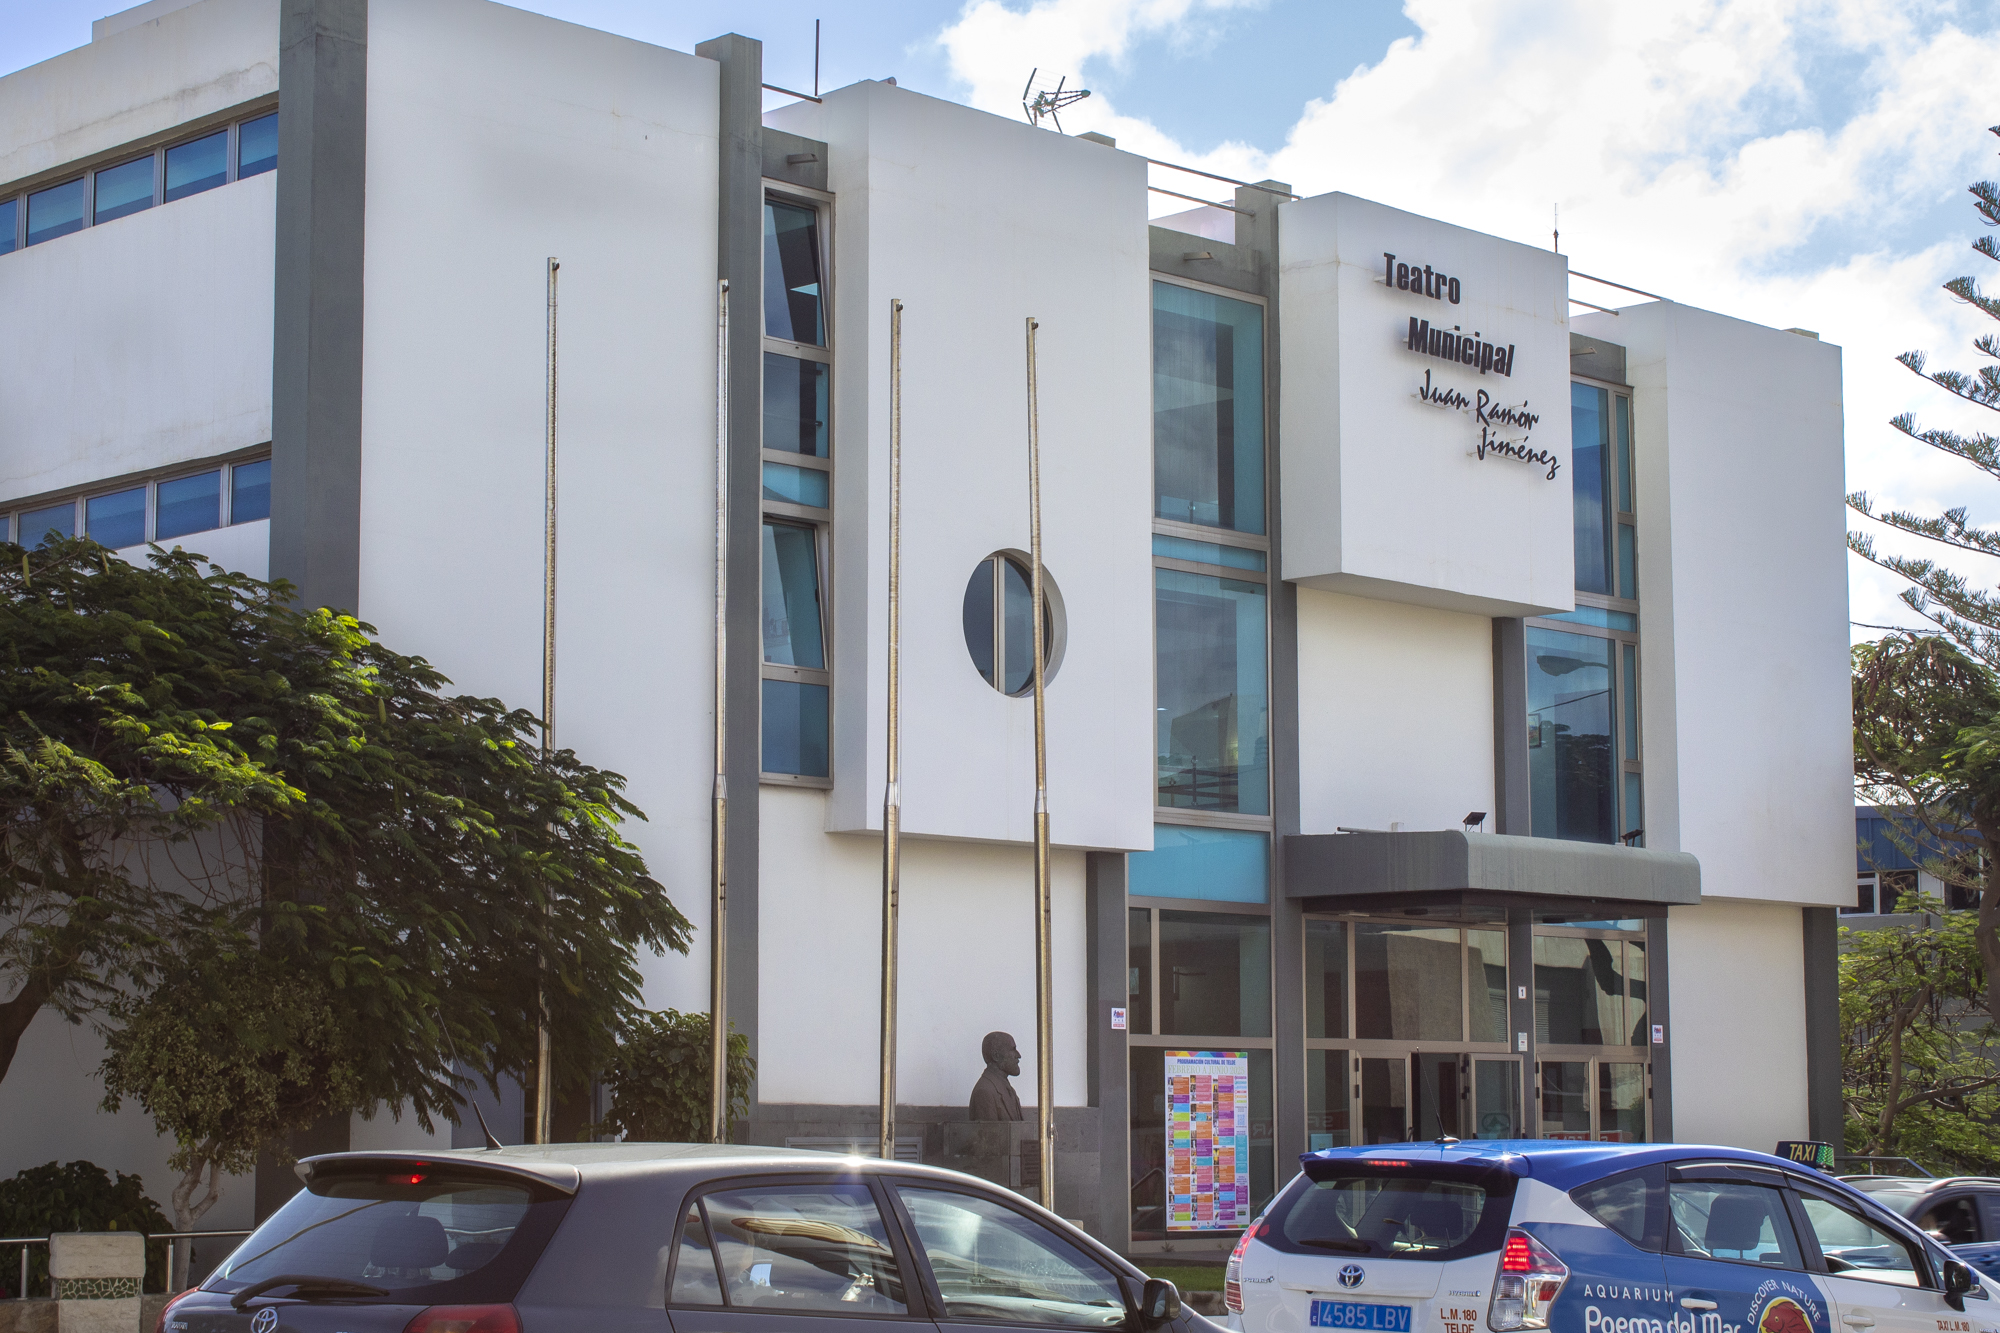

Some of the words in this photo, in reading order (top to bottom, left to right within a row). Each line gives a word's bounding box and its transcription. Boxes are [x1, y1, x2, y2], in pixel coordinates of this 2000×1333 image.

[1383, 252, 1461, 304] Teatro
[1407, 316, 1515, 377] Municipal
[1419, 368, 1470, 410] Juan
[1475, 388, 1540, 430] Ramón
[1476, 426, 1561, 480] Jiménez
[1168, 1065, 1200, 1073] FEBRERO
[1208, 1066, 1228, 1074] JUNIO
[1230, 1066, 1245, 1075] 2025
[1789, 1144, 1816, 1161] TAXI
[1584, 1284, 1674, 1303] AQUARIUM
[1747, 1279, 1780, 1325] DISCOVER
[1781, 1280, 1821, 1322] NATURE
[1322, 1304, 1367, 1327] 4585
[1372, 1307, 1409, 1330] LBV
[1444, 1322, 1475, 1333] TELDE
[1585, 1305, 1663, 1333] Poema
[1667, 1312, 1696, 1333] del
[1936, 1320, 1949, 1331] TAXI
